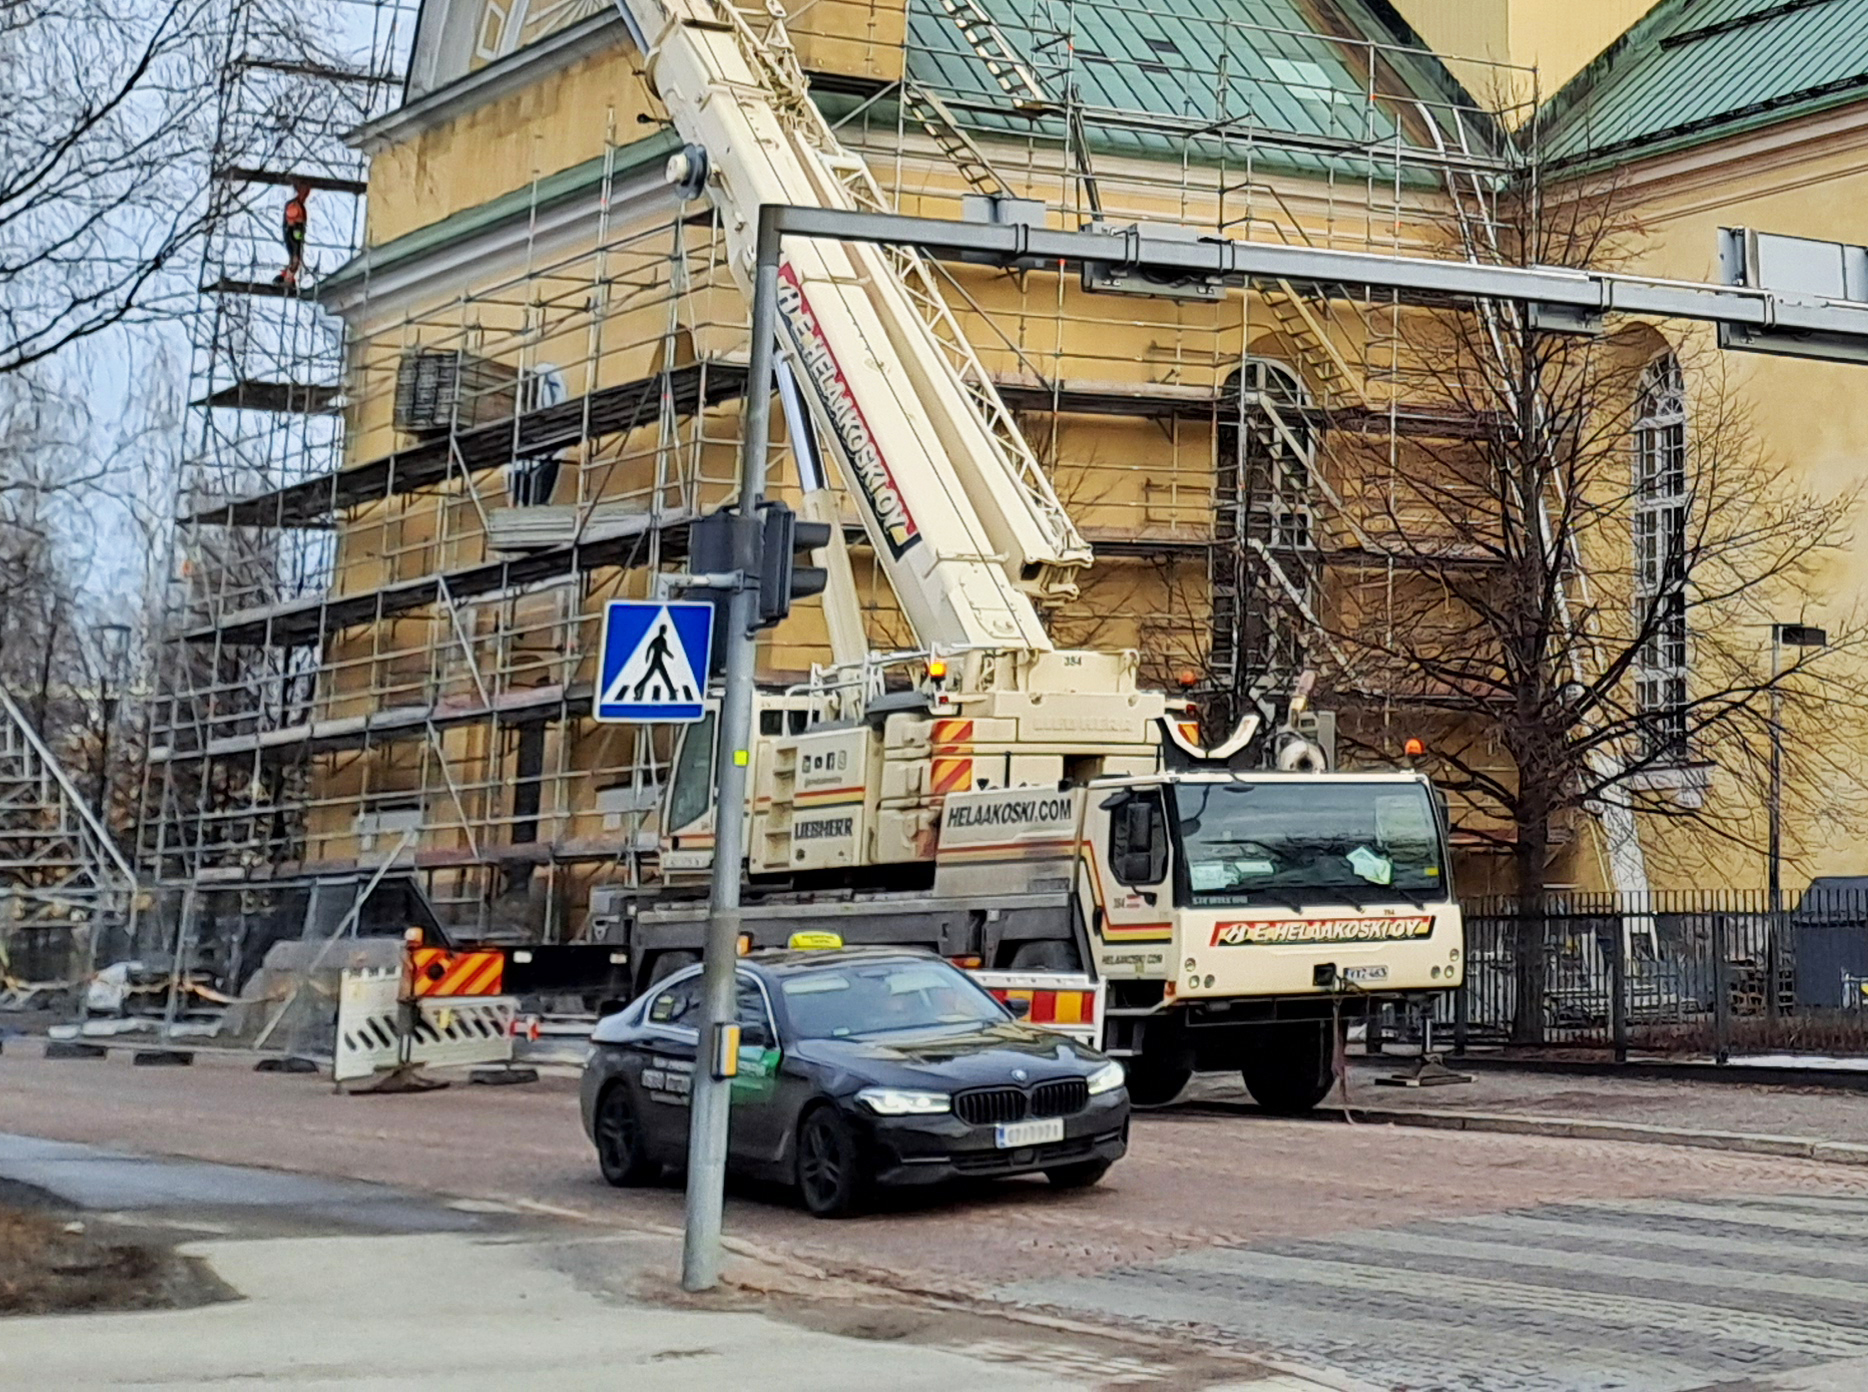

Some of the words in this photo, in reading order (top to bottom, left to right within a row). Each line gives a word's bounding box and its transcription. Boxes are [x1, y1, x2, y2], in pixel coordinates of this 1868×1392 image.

[802, 336, 887, 497] HELAAKOSKI
[875, 489, 907, 537] OY
[947, 798, 1072, 828] HELAAKOSKI.COM
[794, 817, 853, 841] LIEBHERR
[1273, 918, 1388, 942] HELAAKOSKI
[1394, 918, 1421, 937] OY
